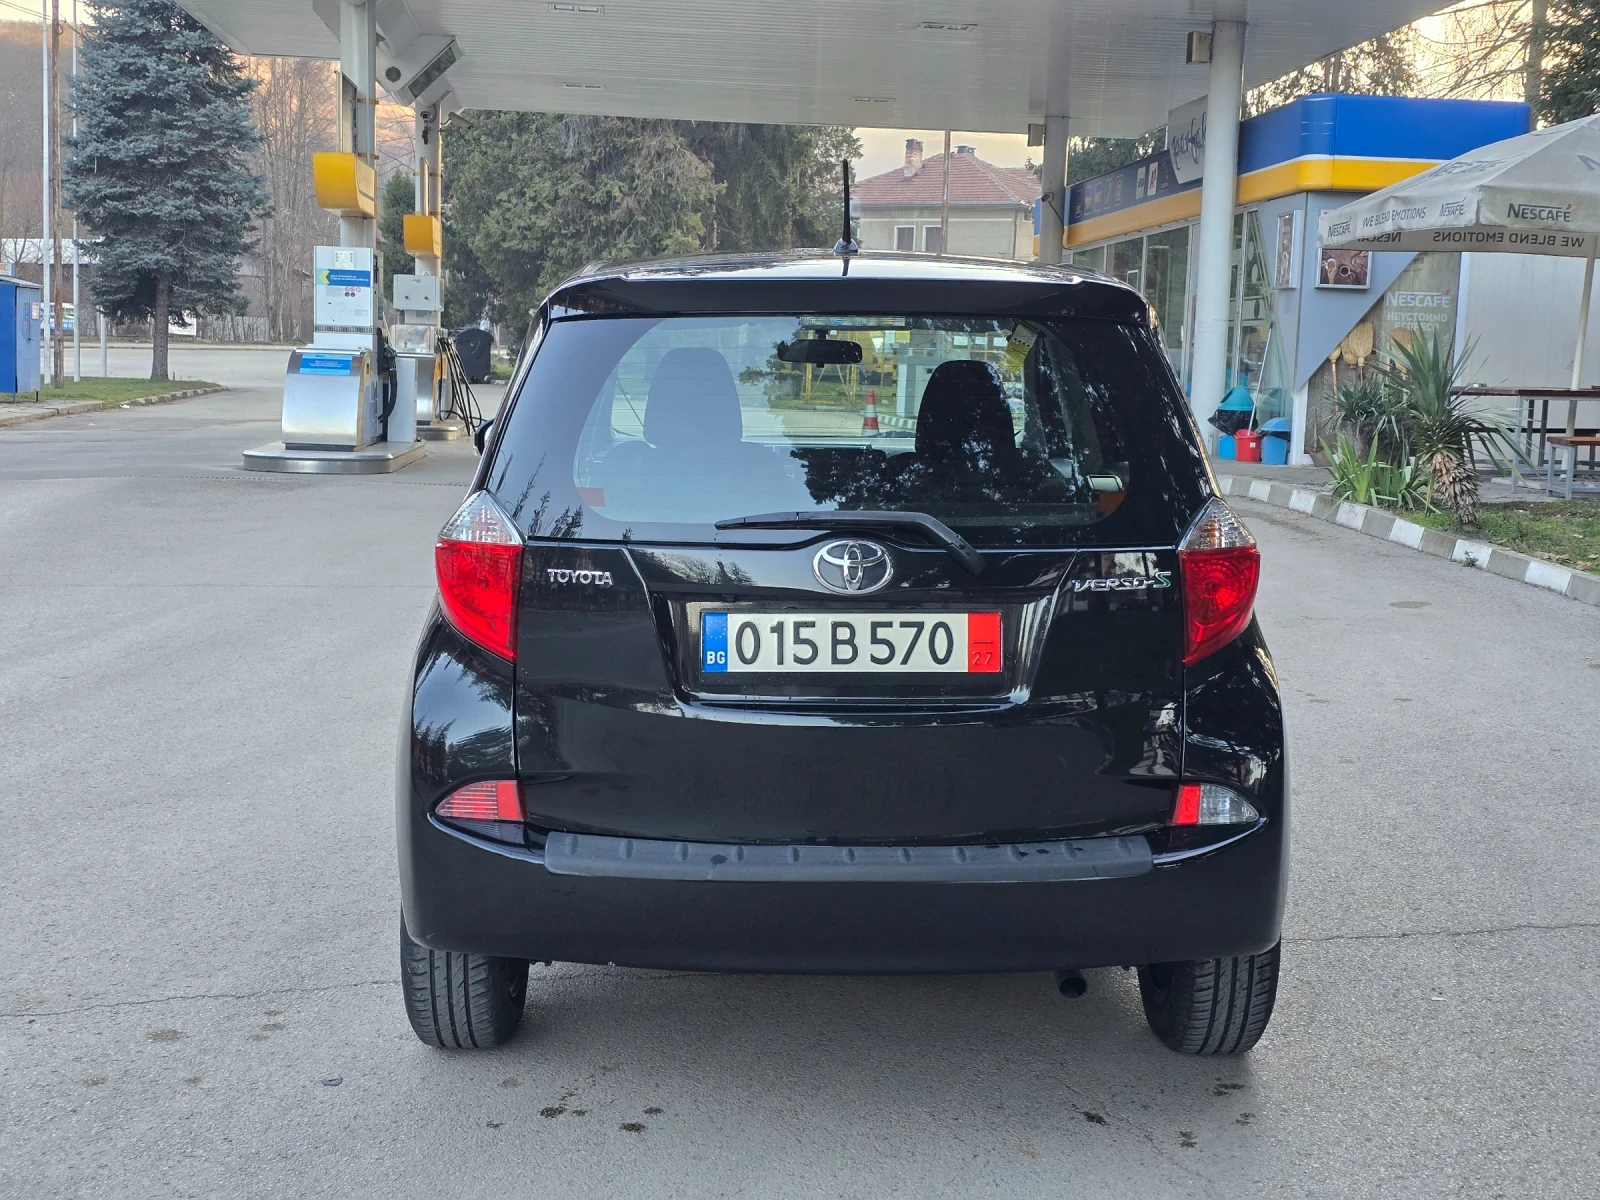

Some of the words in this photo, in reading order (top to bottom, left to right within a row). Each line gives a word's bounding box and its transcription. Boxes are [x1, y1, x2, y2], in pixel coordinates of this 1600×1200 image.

[1362, 216, 1374, 228] WE
[1391, 206, 1427, 221] EMOTIONS
[1507, 203, 1572, 222] NESCAFÉ
[1387, 311, 1448, 322] НЕУСТОИМО
[547, 568, 614, 586] TOYOTA
[706, 651, 726, 664] BG
[972, 650, 993, 666] 27
